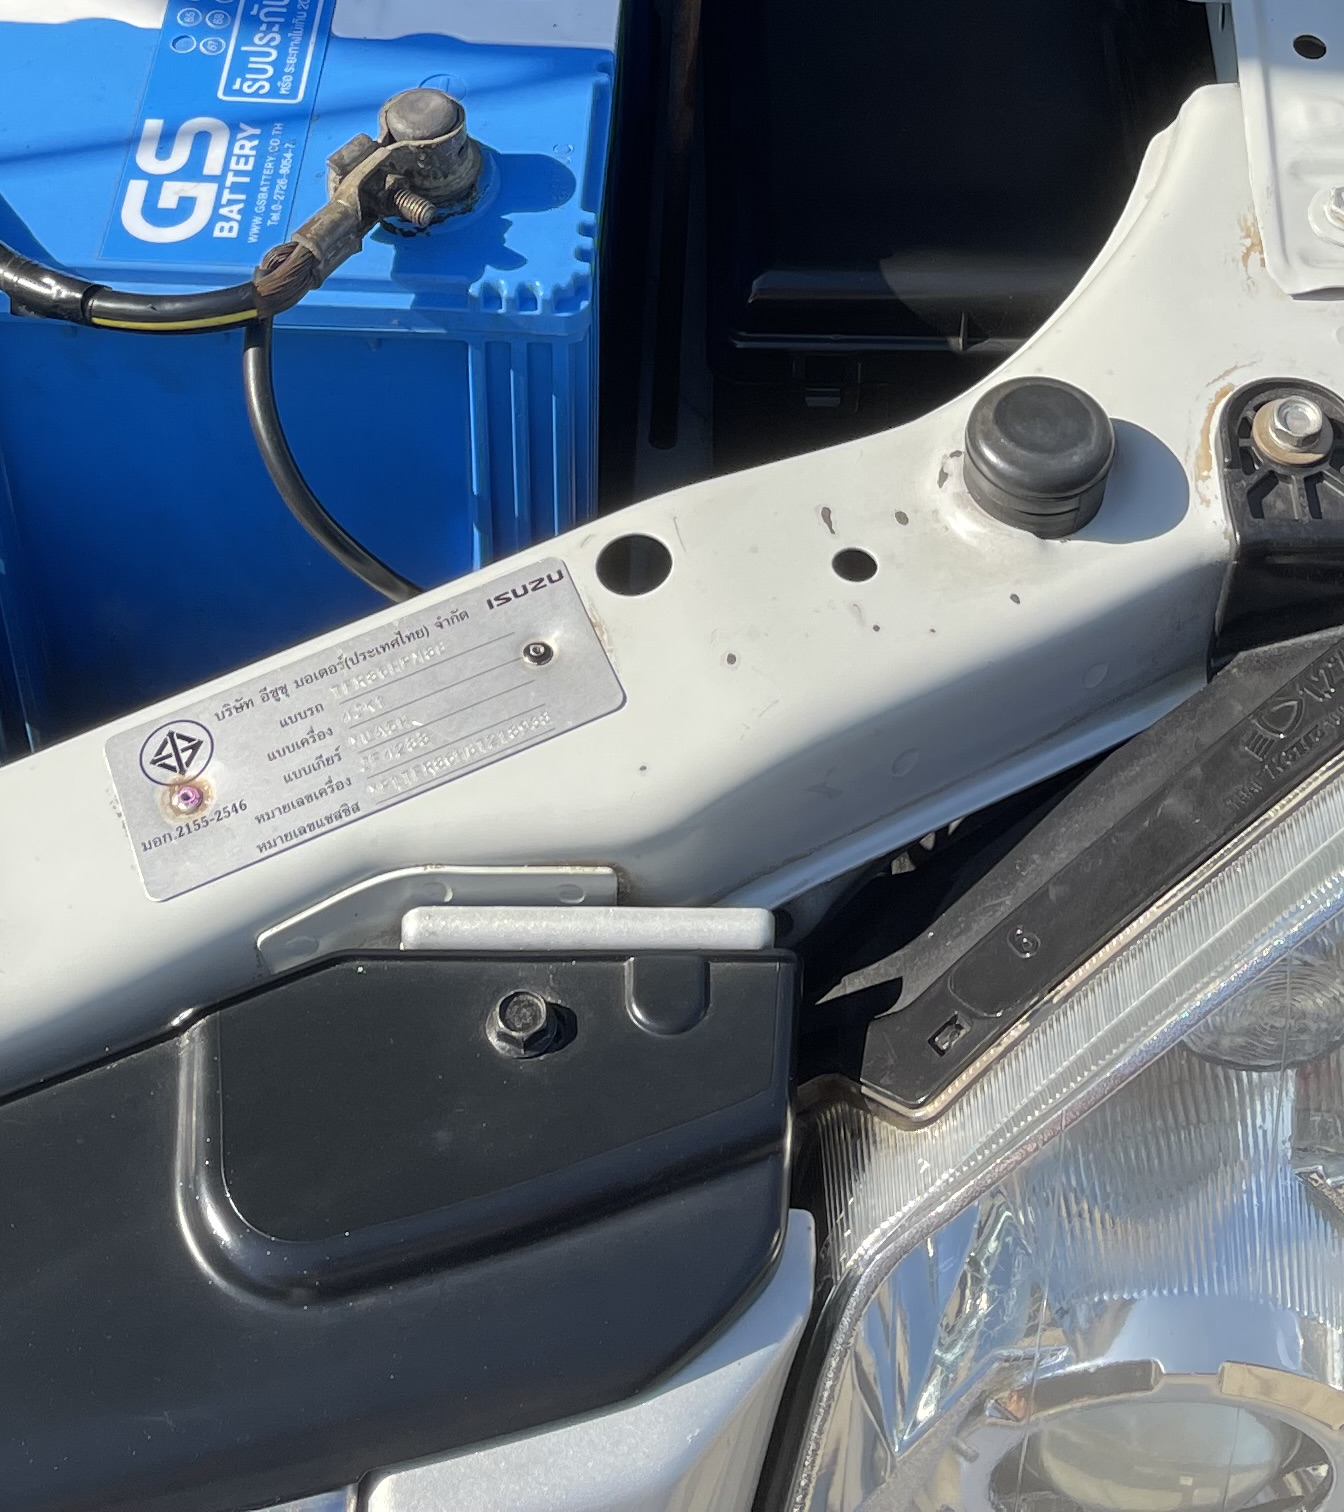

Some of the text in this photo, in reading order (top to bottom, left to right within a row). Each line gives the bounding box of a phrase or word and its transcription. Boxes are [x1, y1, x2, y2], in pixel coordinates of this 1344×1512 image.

[277, 75, 293, 94] หรือ
[121, 116, 230, 243] GS
[213, 122, 261, 238] BATTERY
[486, 569, 565, 611] ISUZU
[215, 695, 256, 722] บริษัท
[294, 620, 431, 690] มอเตอร์(ประเทศไทย)
[433, 607, 470, 633] จำกัด
[279, 700, 325, 730] แบบรถ
[266, 723, 335, 763] แบบเครื่อง
[282, 746, 343, 785] แบบเกียร์
[254, 773, 353, 825] หมายเลขเครื่อง
[141, 798, 249, 853] มอก.2155-2546
